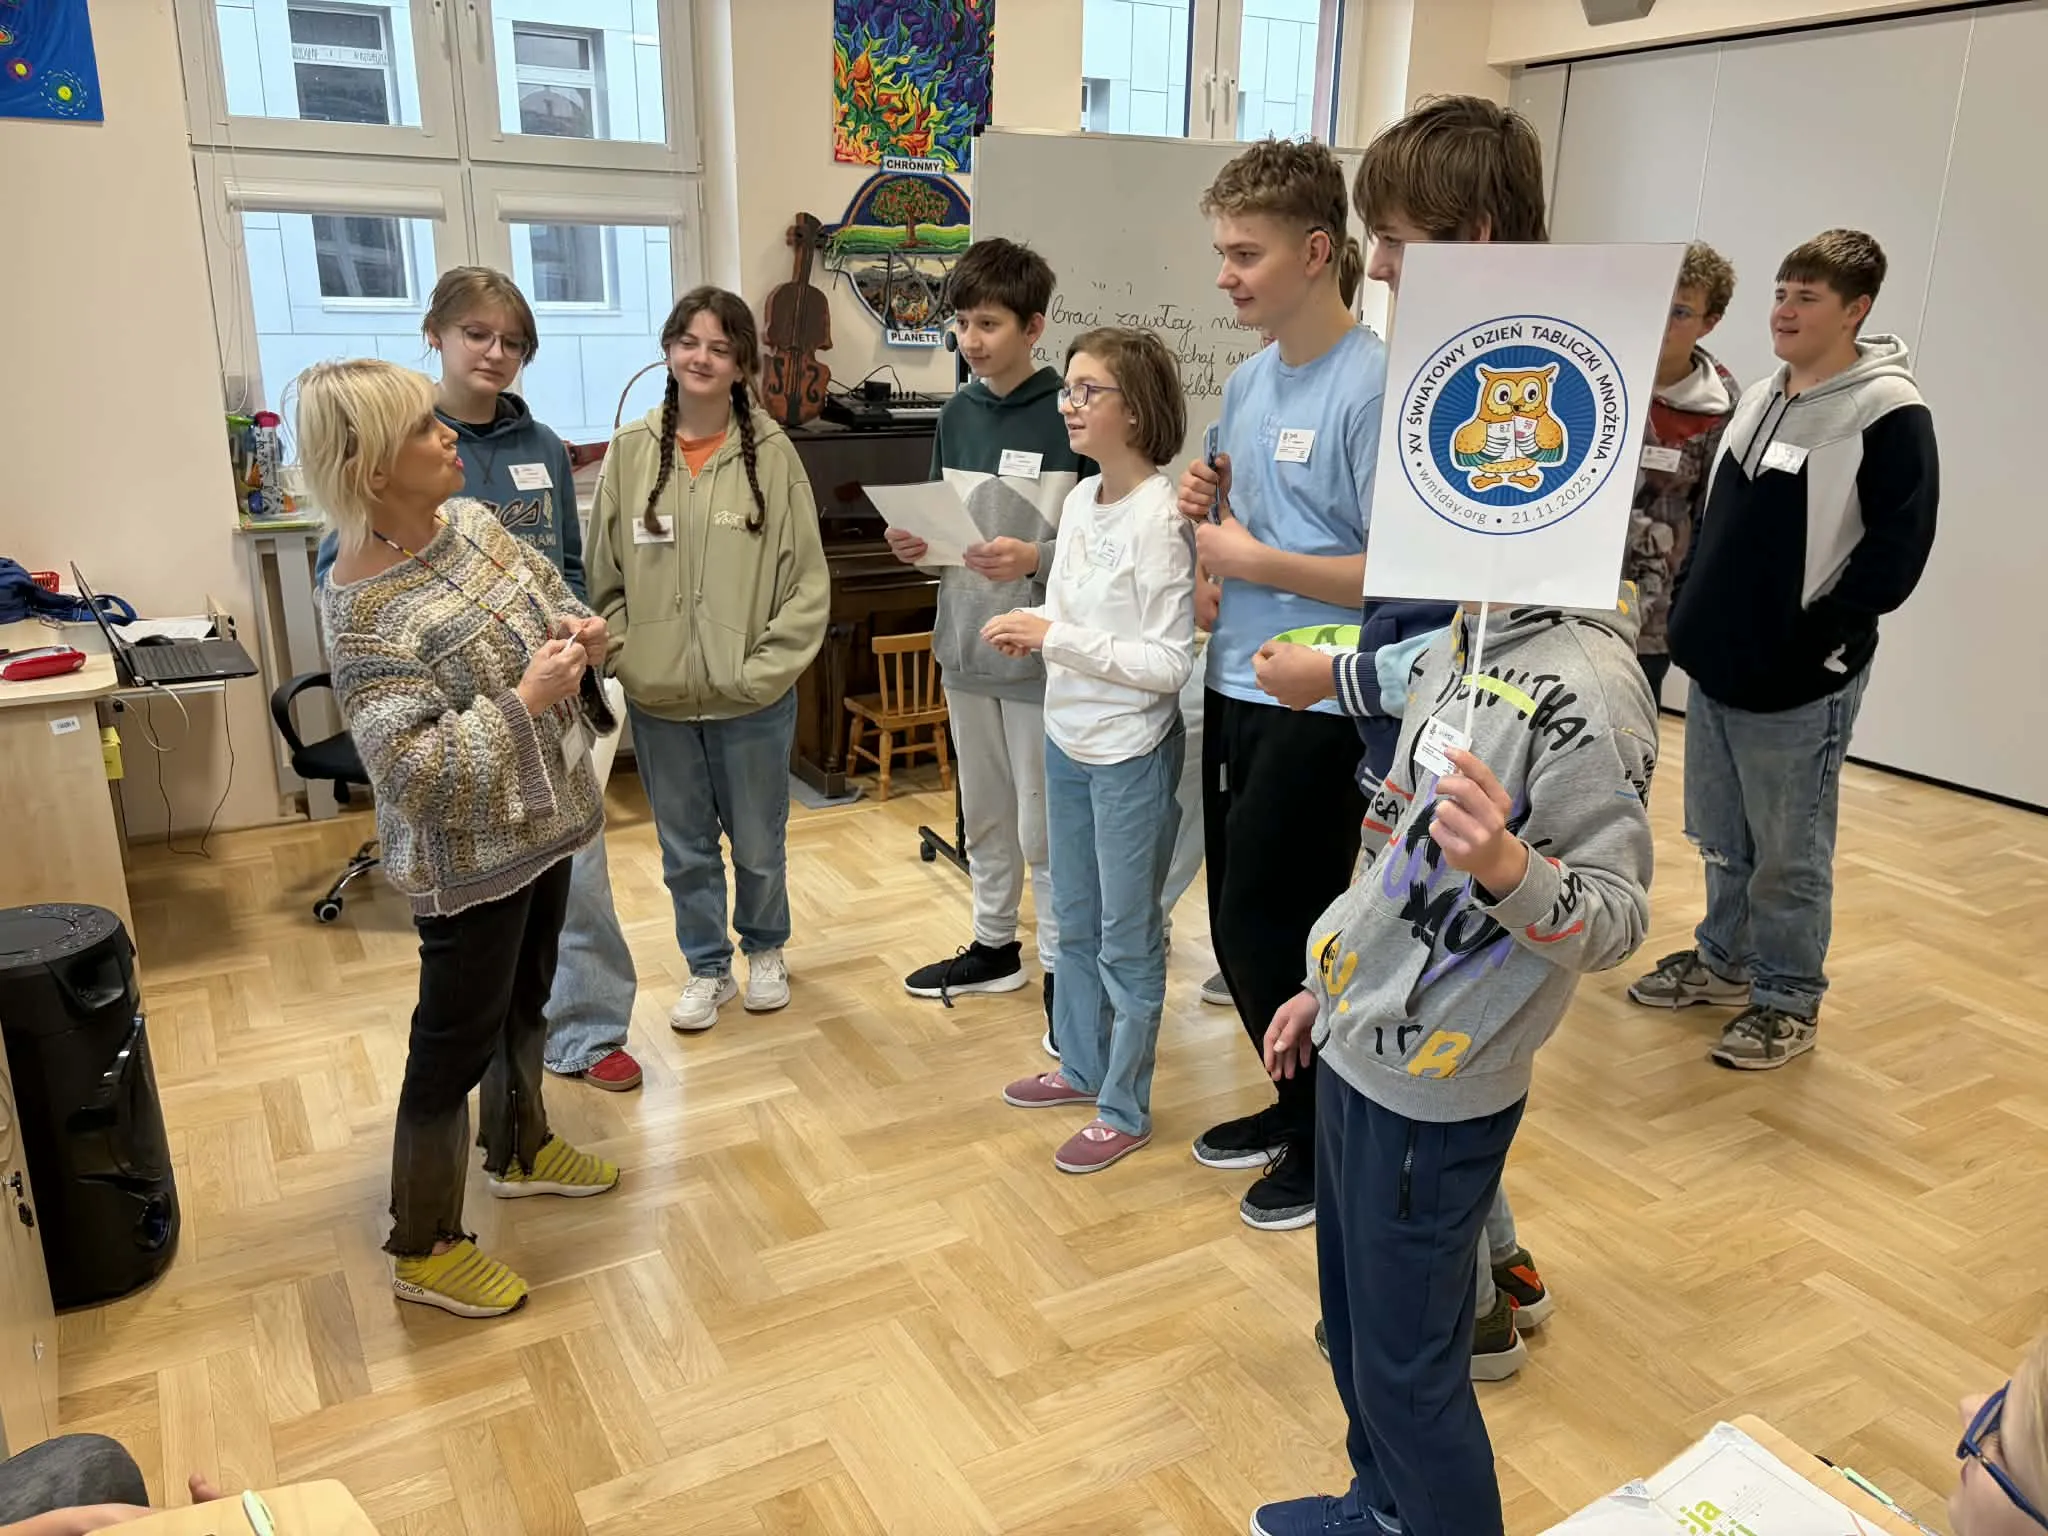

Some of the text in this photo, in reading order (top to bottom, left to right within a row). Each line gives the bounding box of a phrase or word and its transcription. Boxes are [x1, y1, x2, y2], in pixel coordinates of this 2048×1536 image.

[1472, 322, 1524, 349] DZIEŃ
[1531, 325, 1603, 372] TABLICZKI
[1406, 344, 1467, 426] ŚWIATOWY
[1593, 374, 1621, 461] MNOŻENIA
[1408, 433, 1424, 455] XV
[1419, 469, 1488, 525] wmtday.org
[1511, 474, 1592, 524] 21.11.2025
